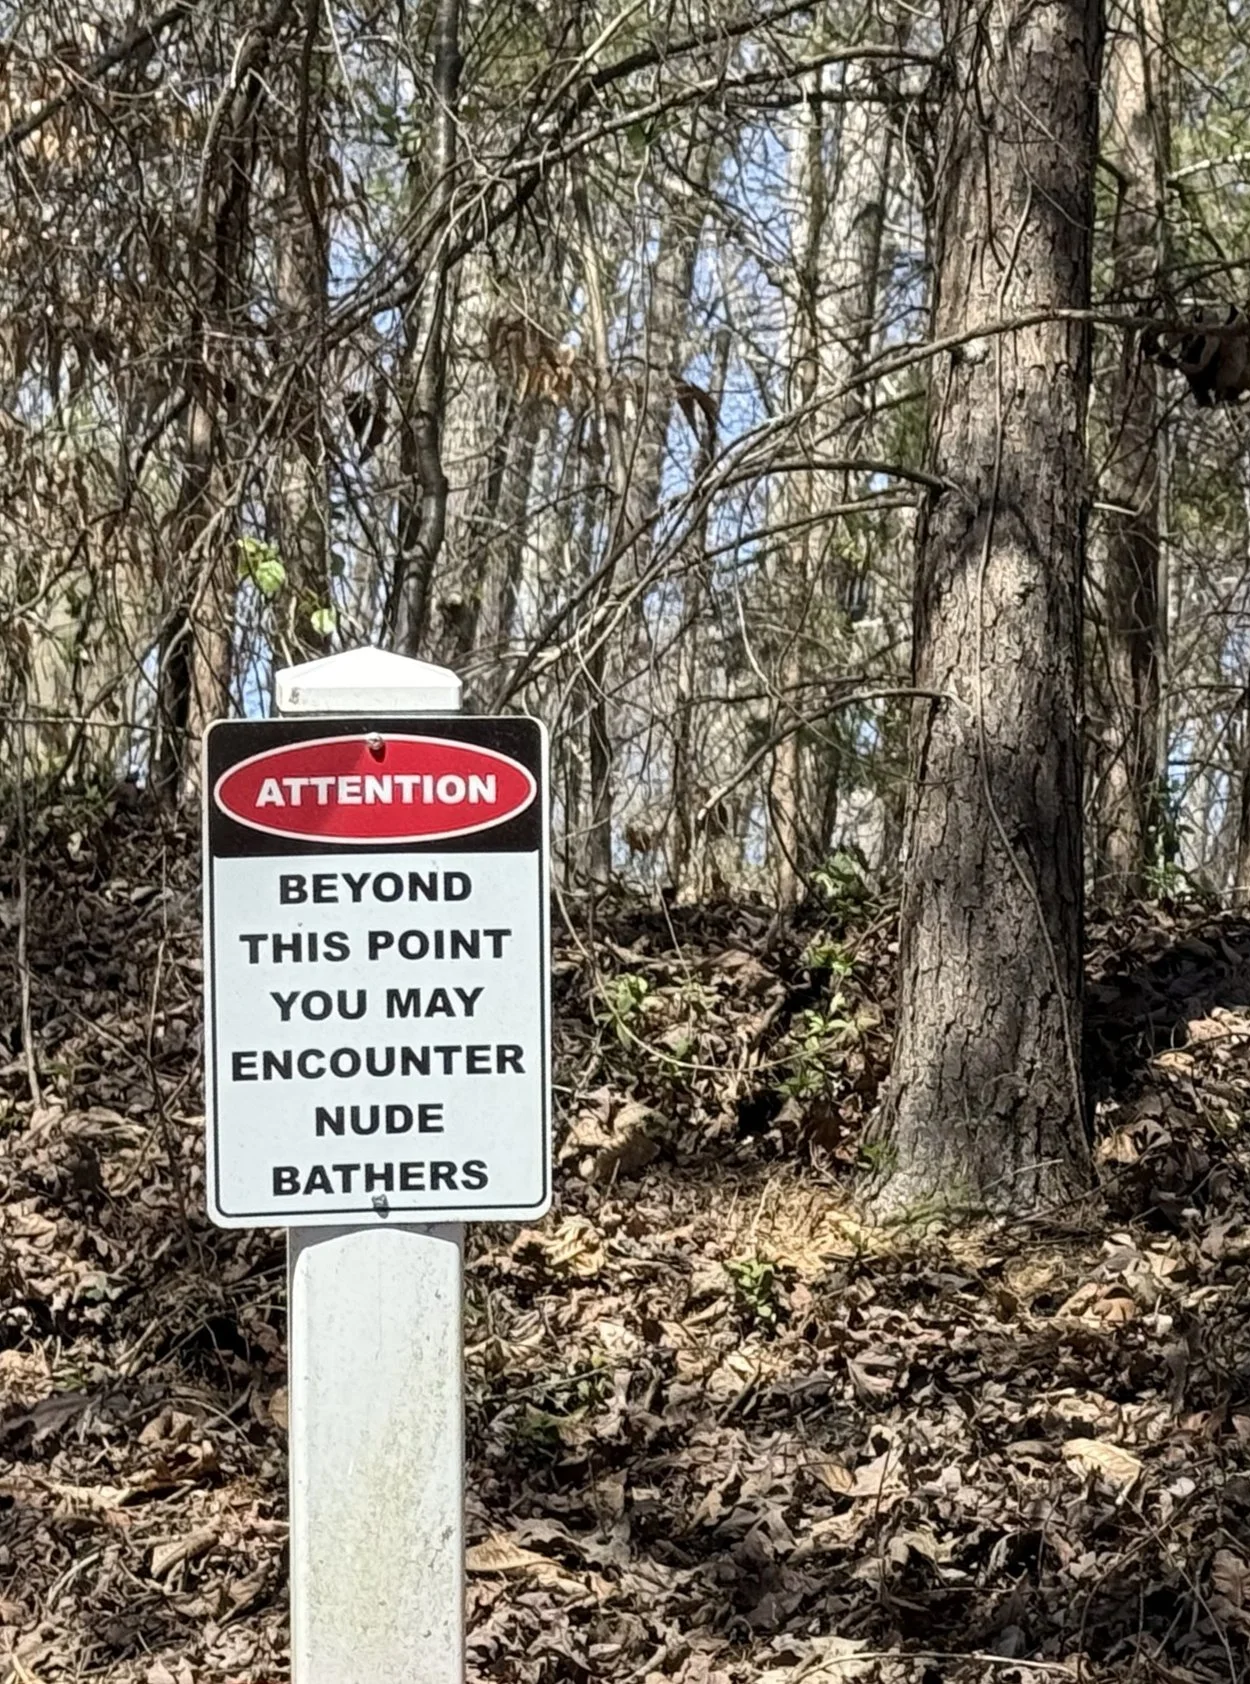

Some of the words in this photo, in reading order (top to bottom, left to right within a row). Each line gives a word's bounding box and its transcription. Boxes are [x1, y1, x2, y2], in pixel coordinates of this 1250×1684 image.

[254, 774, 497, 807] ATTENTION
[279, 871, 472, 905] BEYOND
[239, 931, 350, 964] THIS
[368, 929, 512, 960] POINT
[270, 989, 367, 1022] YOU
[386, 987, 485, 1019] MAY
[231, 1044, 526, 1082] ENCOUNTER
[315, 1103, 444, 1137] NUDE
[272, 1160, 489, 1196] BATHERS
